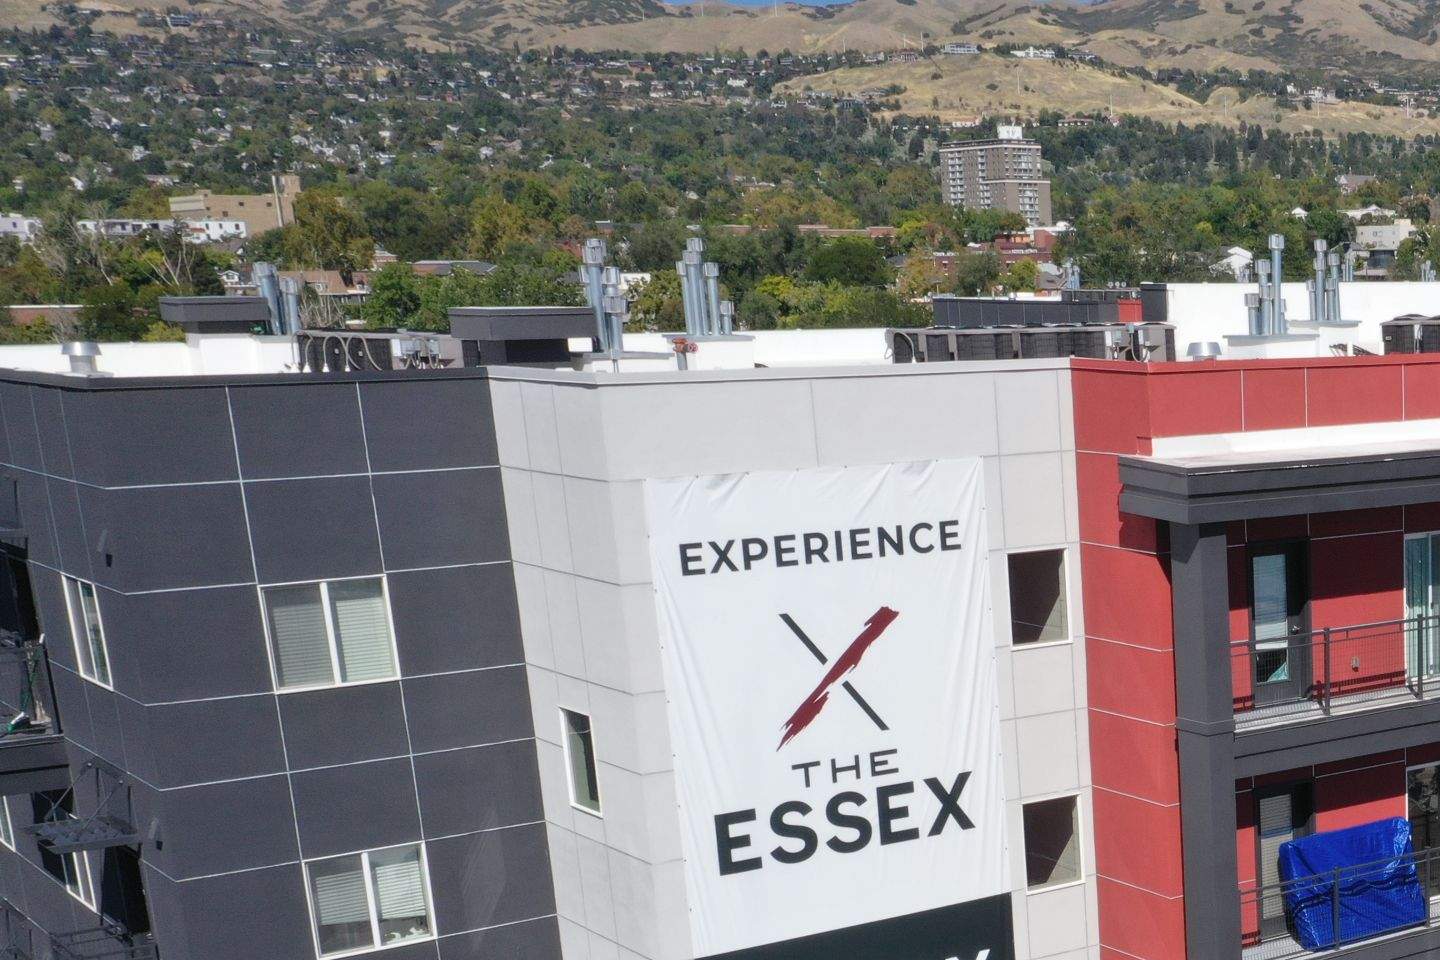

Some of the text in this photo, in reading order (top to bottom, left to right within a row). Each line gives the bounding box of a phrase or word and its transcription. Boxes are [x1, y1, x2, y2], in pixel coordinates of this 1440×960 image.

[679, 519, 963, 577] EXPERIENCE
[791, 748, 899, 788] THE
[714, 771, 976, 877] ESSEX
